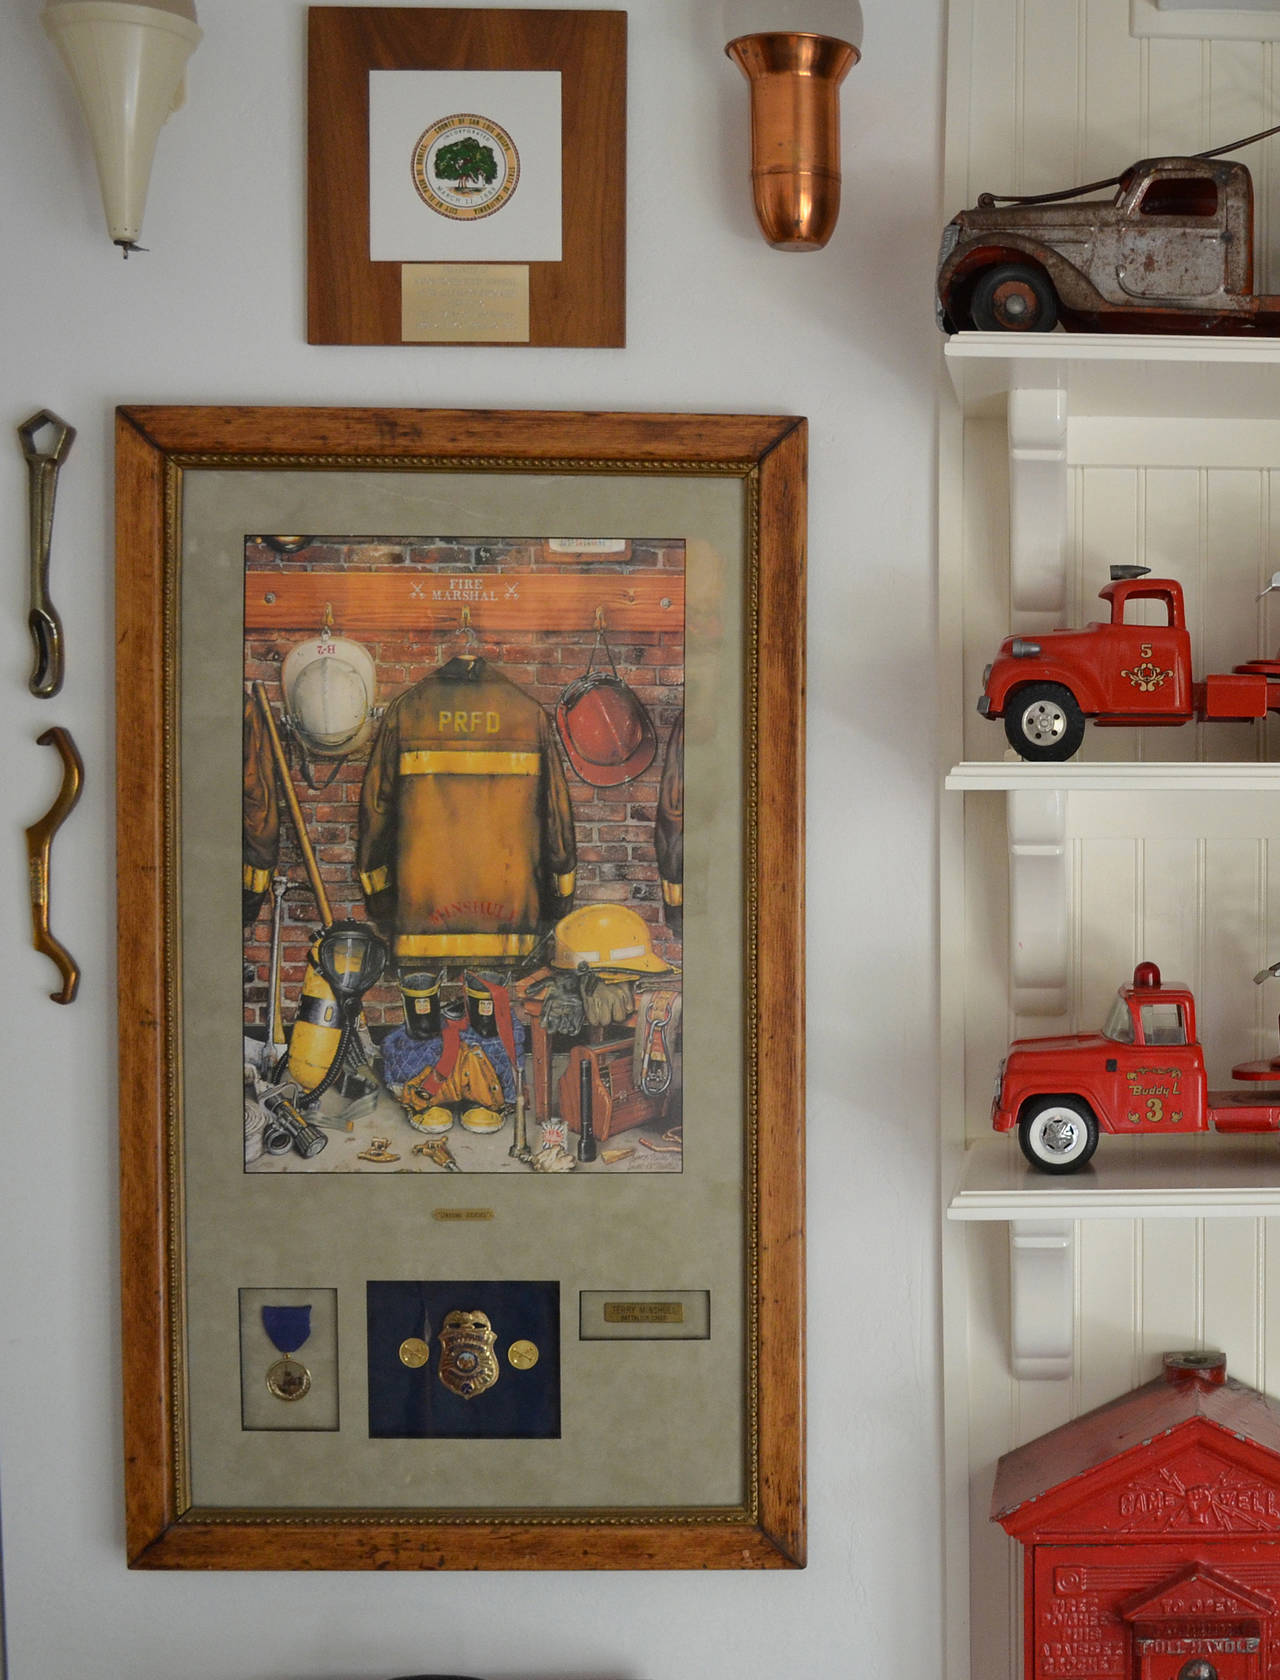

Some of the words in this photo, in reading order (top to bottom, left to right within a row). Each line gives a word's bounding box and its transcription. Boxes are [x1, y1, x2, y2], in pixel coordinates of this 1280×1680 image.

[469, 118, 480, 126] SAN
[443, 128, 491, 142] INCORPORATED
[450, 579, 484, 590] FIRE
[432, 590, 499, 601] MARSHAL
[1141, 643, 1152, 658] 5
[437, 711, 501, 734] PRFD
[1128, 1085, 1170, 1099] Buddy
[1172, 1081, 1182, 1095] L
[1146, 1097, 1164, 1122] 3
[1161, 1599, 1185, 1613] TO
[1191, 1598, 1241, 1615] OPEN
[1142, 1639, 1185, 1655] PULL
[1188, 1637, 1261, 1654] HANDLE
